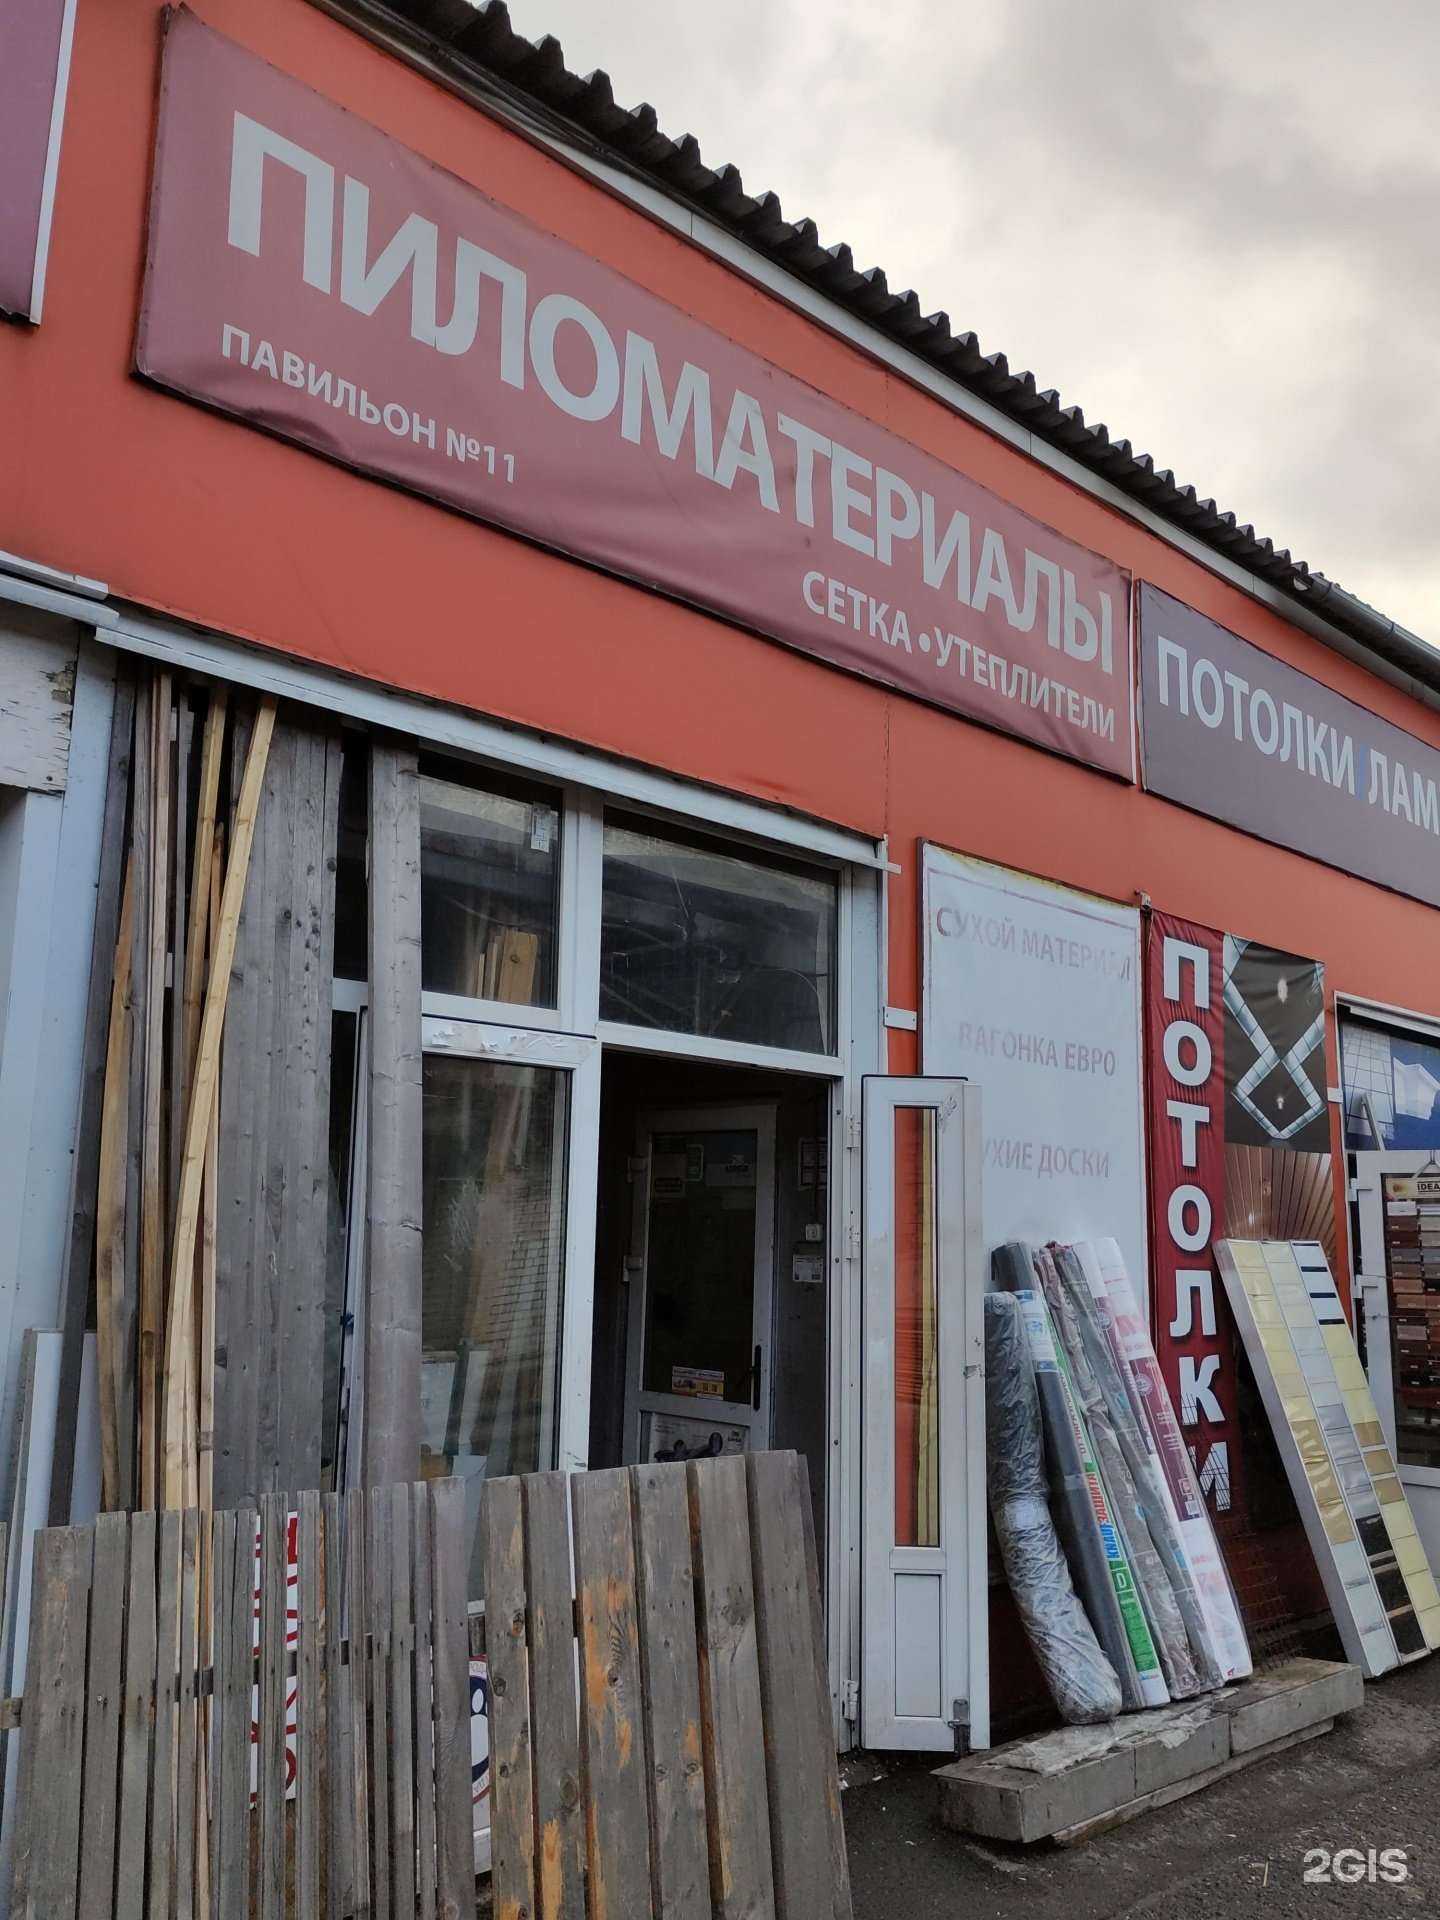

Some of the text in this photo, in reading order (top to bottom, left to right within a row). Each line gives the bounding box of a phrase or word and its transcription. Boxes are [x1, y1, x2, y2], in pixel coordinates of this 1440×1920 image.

[222, 323, 516, 484] ПАВИЛЬОН №11
[228, 110, 1112, 675] ПИЛОМАТЕРИАЛЫ
[802, 571, 1115, 742] СЕТКА УТЕПЛИТЕЛИ
[1157, 634, 1355, 796] ПОТОЛКИ
[936, 906, 1015, 953] СУХОЙ
[958, 1022, 1116, 1077] ВАГОНКА ЕВРО
[1038, 1143, 1110, 1179] ДОСКИ
[1163, 936, 1231, 1512] ПОТОЛКИ
